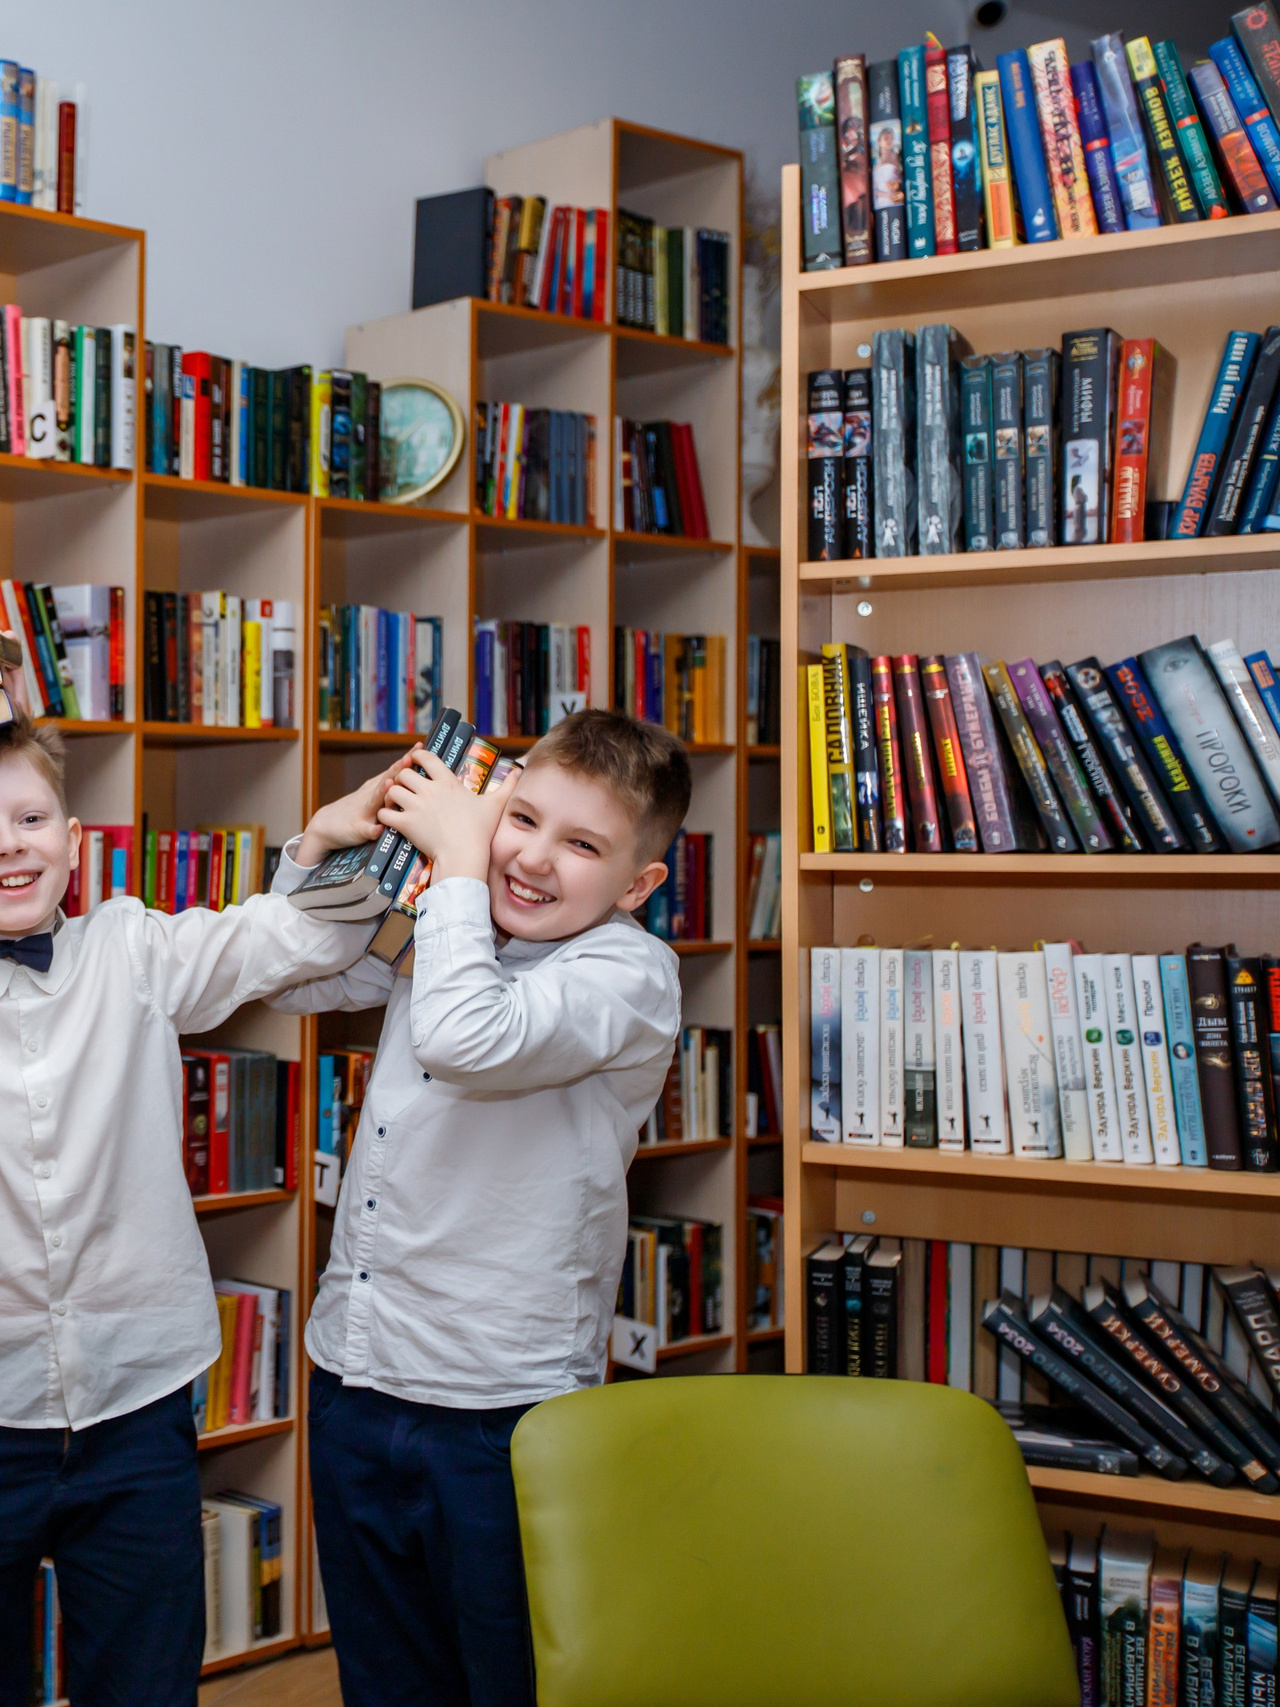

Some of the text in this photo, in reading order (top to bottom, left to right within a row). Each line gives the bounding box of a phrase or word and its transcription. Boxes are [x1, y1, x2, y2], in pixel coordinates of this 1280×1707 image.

[981, 85, 1005, 164] ДУГЛАС АДАМС
[1255, 121, 1280, 164] АЗИМОВ
[1140, 85, 1195, 212] АЙЗЕК АЗИМОВ
[1181, 126, 1219, 202] АЙЗЕК АЗИМОВ
[1090, 150, 1118, 225] АЙЗЕК АЗИМОВ
[1079, 377, 1095, 423] МИФЫ
[31, 413, 47, 442] С
[1178, 335, 1248, 536] КИР БУЛЫЧЕВ Разум для кота
[813, 485, 825, 518] ПОЛ
[822, 458, 837, 543] АНДЕРСОН
[845, 484, 857, 518] ПОЛ
[855, 458, 870, 541] АНДЕРСОН
[1215, 457, 1242, 521] Александр Беляев
[809, 670, 820, 701] БОВА
[426, 721, 453, 755] ДМИТРИ
[854, 682, 871, 750] ИЩЕЙКА
[439, 735, 466, 768] ДМИТРИ
[950, 661, 1001, 823] БОМБЫ БУМЕРАНГИ
[1147, 731, 1194, 798] Академия
[1195, 726, 1252, 815] ПРОРОКИ
[380, 833, 395, 853] 2033
[394, 849, 408, 871] 2033
[1113, 965, 1126, 1024] Место снов
[1140, 978, 1155, 1017] Пролог
[1197, 1016, 1227, 1028] Дым
[1089, 1047, 1103, 1090] Веркин
[1119, 1048, 1135, 1091] Веркин
[1147, 1049, 1164, 1093] Веркин
[856, 1079, 867, 1108] богов
[314, 1161, 330, 1189] Т
[996, 1318, 1080, 1395] МЕТРО 2034
[1043, 1318, 1129, 1397] МЕТРО 2034
[1099, 1311, 1182, 1398] СУМЕРКИ
[1141, 1308, 1224, 1395] СУМЕРКИ
[1181, 1394, 1240, 1457] ДМИТРИЙ ГЛУХОВСКИЙ
[1125, 1620, 1135, 1630] В
[1154, 1611, 1165, 1624] В
[1222, 1625, 1234, 1637] В
[1081, 1637, 1093, 1667] МОРЯ
[1187, 1635, 1199, 1648] В
[1129, 1636, 1149, 1707] БЕГУЩИЙ
[1229, 1644, 1248, 1707] БЕГУЩИ
